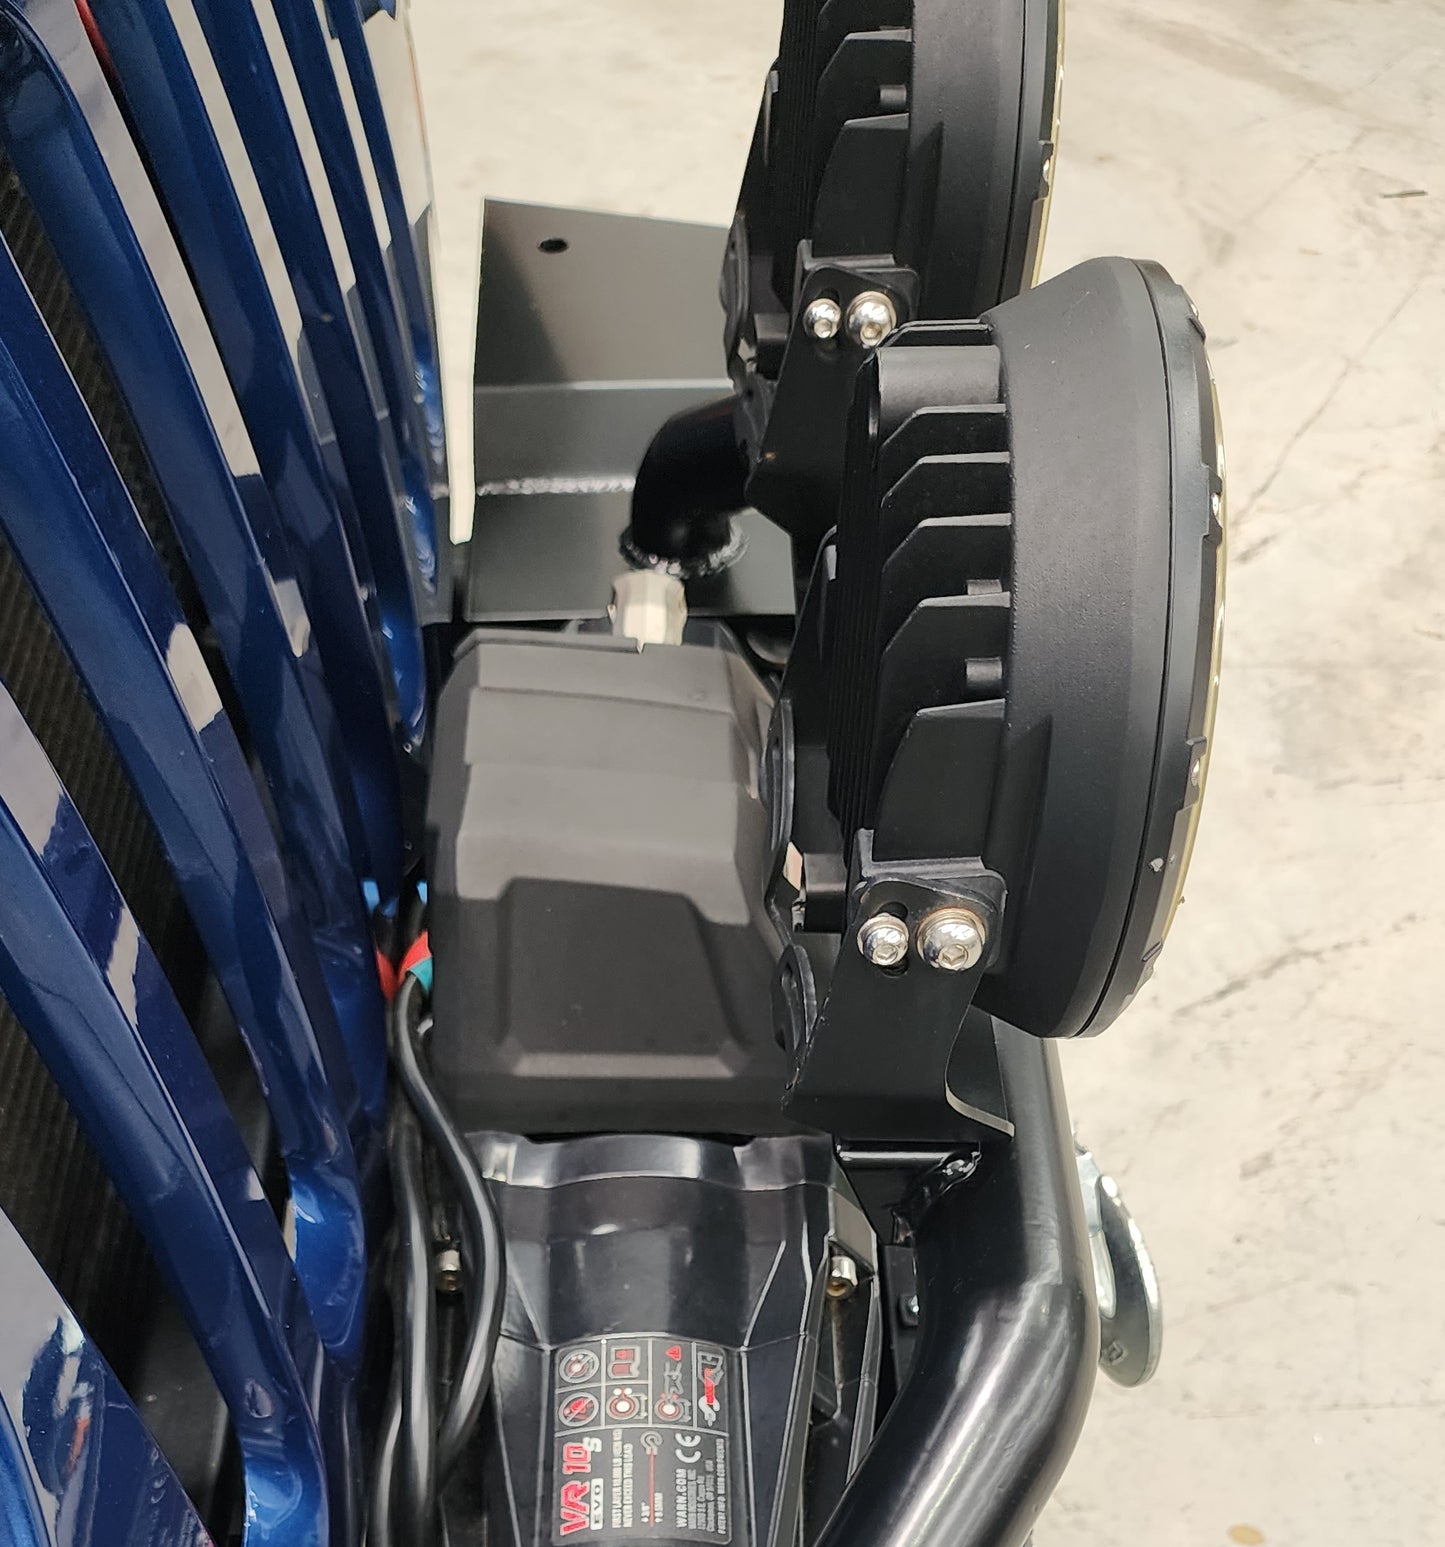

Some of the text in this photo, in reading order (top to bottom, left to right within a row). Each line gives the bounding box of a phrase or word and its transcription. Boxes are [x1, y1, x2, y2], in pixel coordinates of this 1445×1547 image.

[560, 1480, 590, 1536] VR
[593, 1484, 601, 1524] EVO
[676, 1468, 687, 1528] WARN.COM
